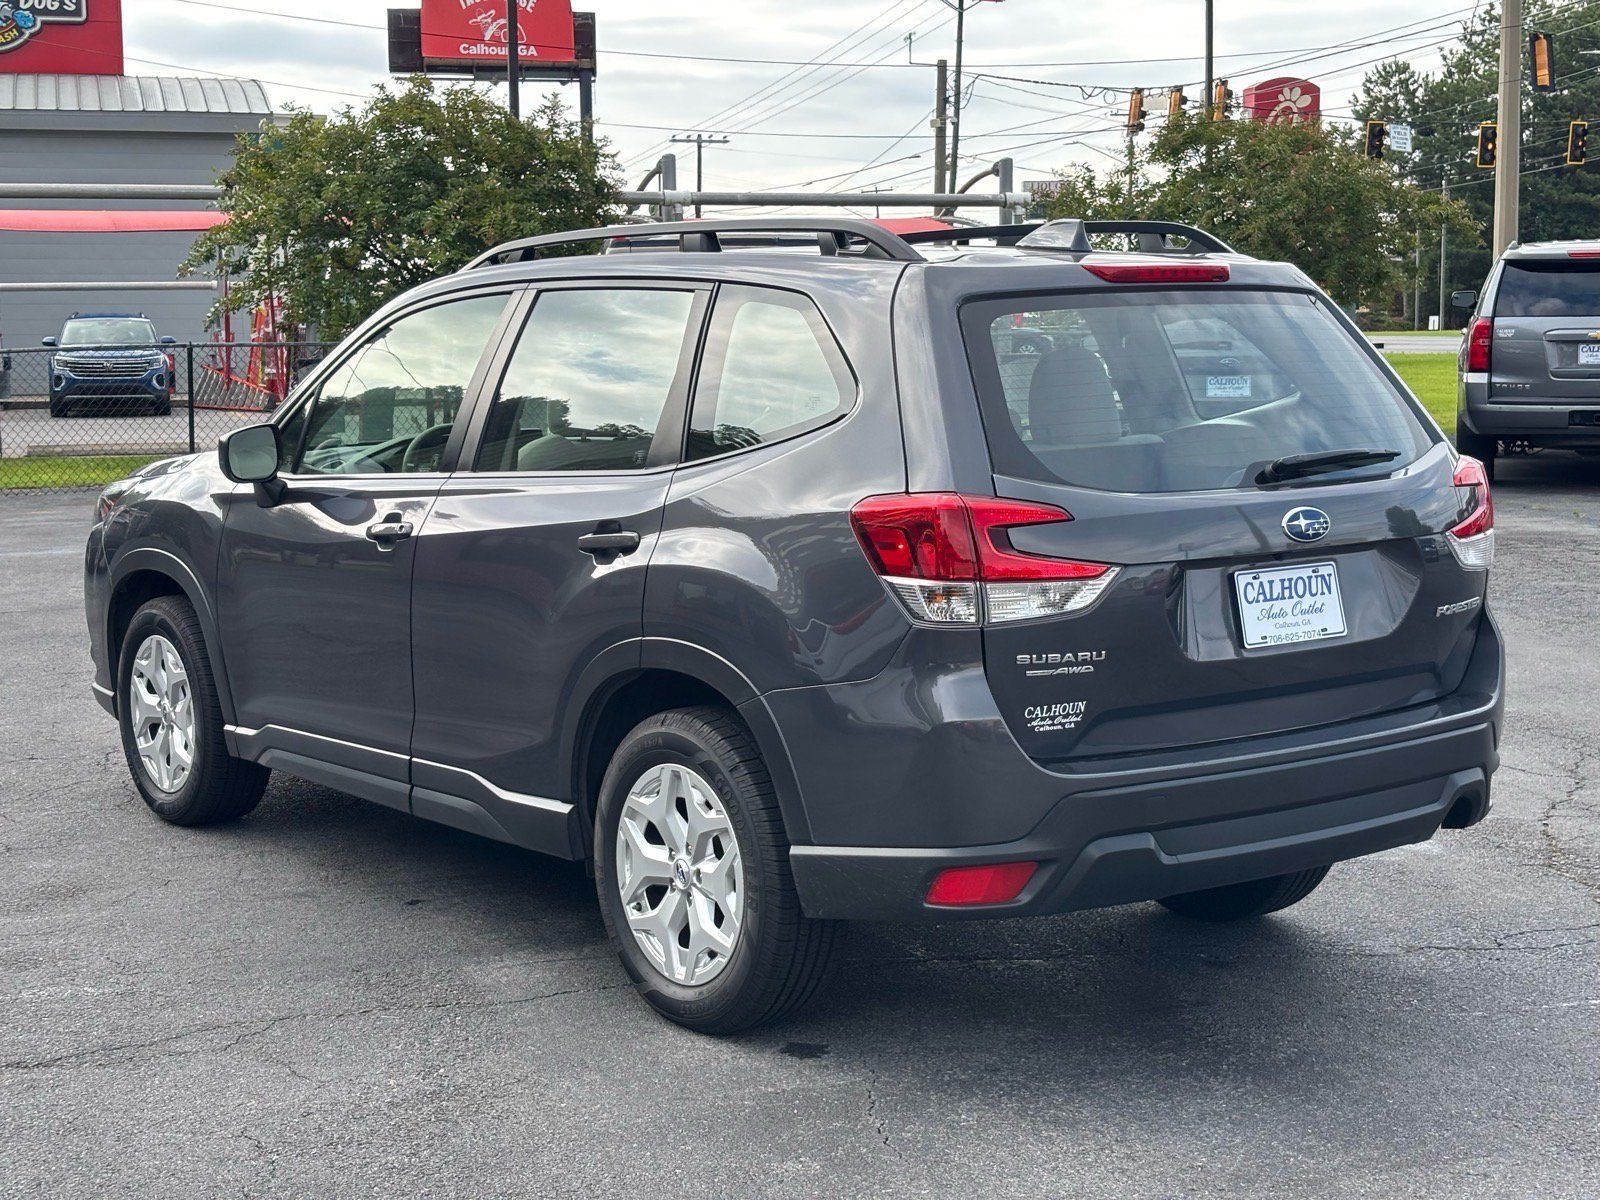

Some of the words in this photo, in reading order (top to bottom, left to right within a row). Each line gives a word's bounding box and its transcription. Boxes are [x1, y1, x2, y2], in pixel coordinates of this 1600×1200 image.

[19, 0, 77, 11] DOGS
[517, 45, 538, 56] GA
[1208, 377, 1249, 386] CALHOUN
[1243, 573, 1333, 605] CALHOUN
[1257, 603, 1289, 622] Auto
[1291, 600, 1326, 618] Outlet
[1301, 619, 1312, 627] GA
[1268, 629, 1321, 645] 706-625-7074
[1016, 650, 1107, 665] SUBARU
[1024, 700, 1087, 719] CALHOUN
[1027, 717, 1054, 728] Auto
[1054, 714, 1083, 725] Outlet
